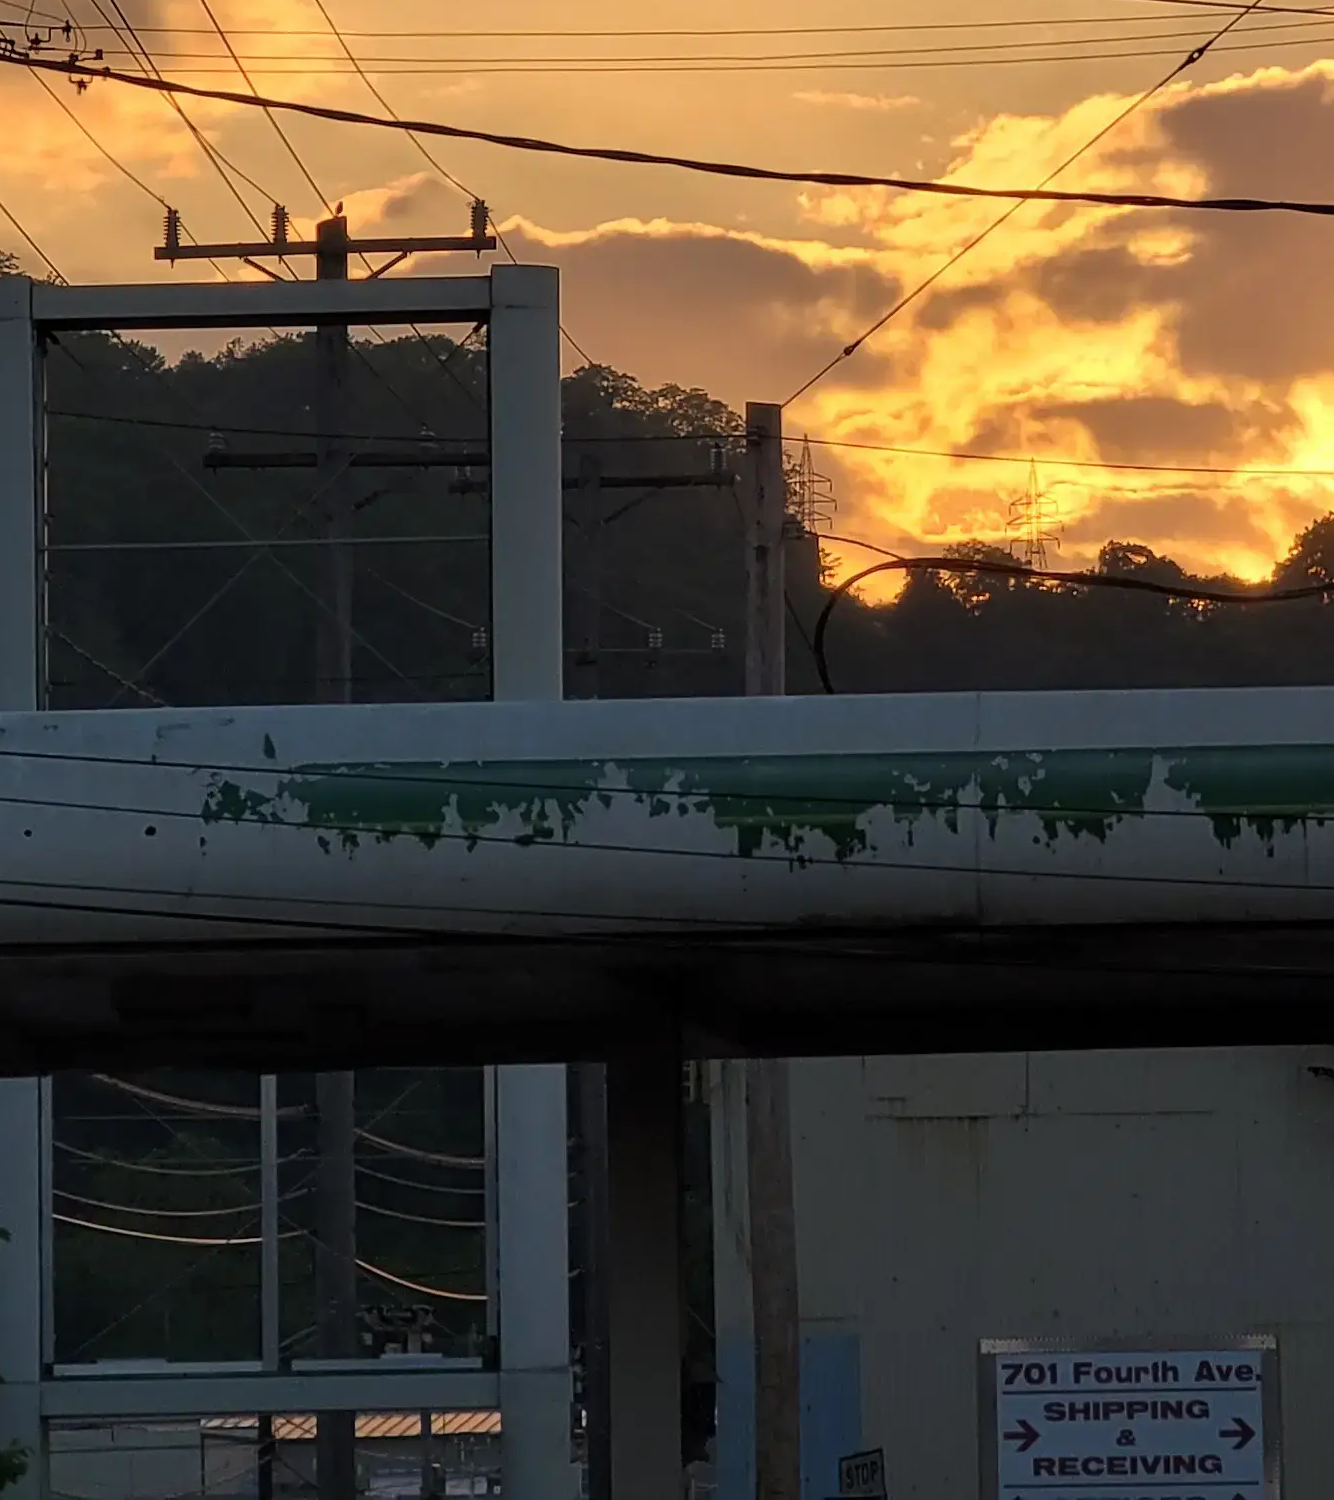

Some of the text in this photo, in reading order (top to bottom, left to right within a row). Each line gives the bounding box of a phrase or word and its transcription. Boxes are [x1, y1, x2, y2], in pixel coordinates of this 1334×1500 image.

[1001, 1360, 1262, 1385] 701 Fourth Ave.
[1043, 1400, 1210, 1421] SHIPPING
[1116, 1429, 1136, 1446] &
[846, 1460, 879, 1490] STOP
[1032, 1454, 1222, 1476] RECEIVING
